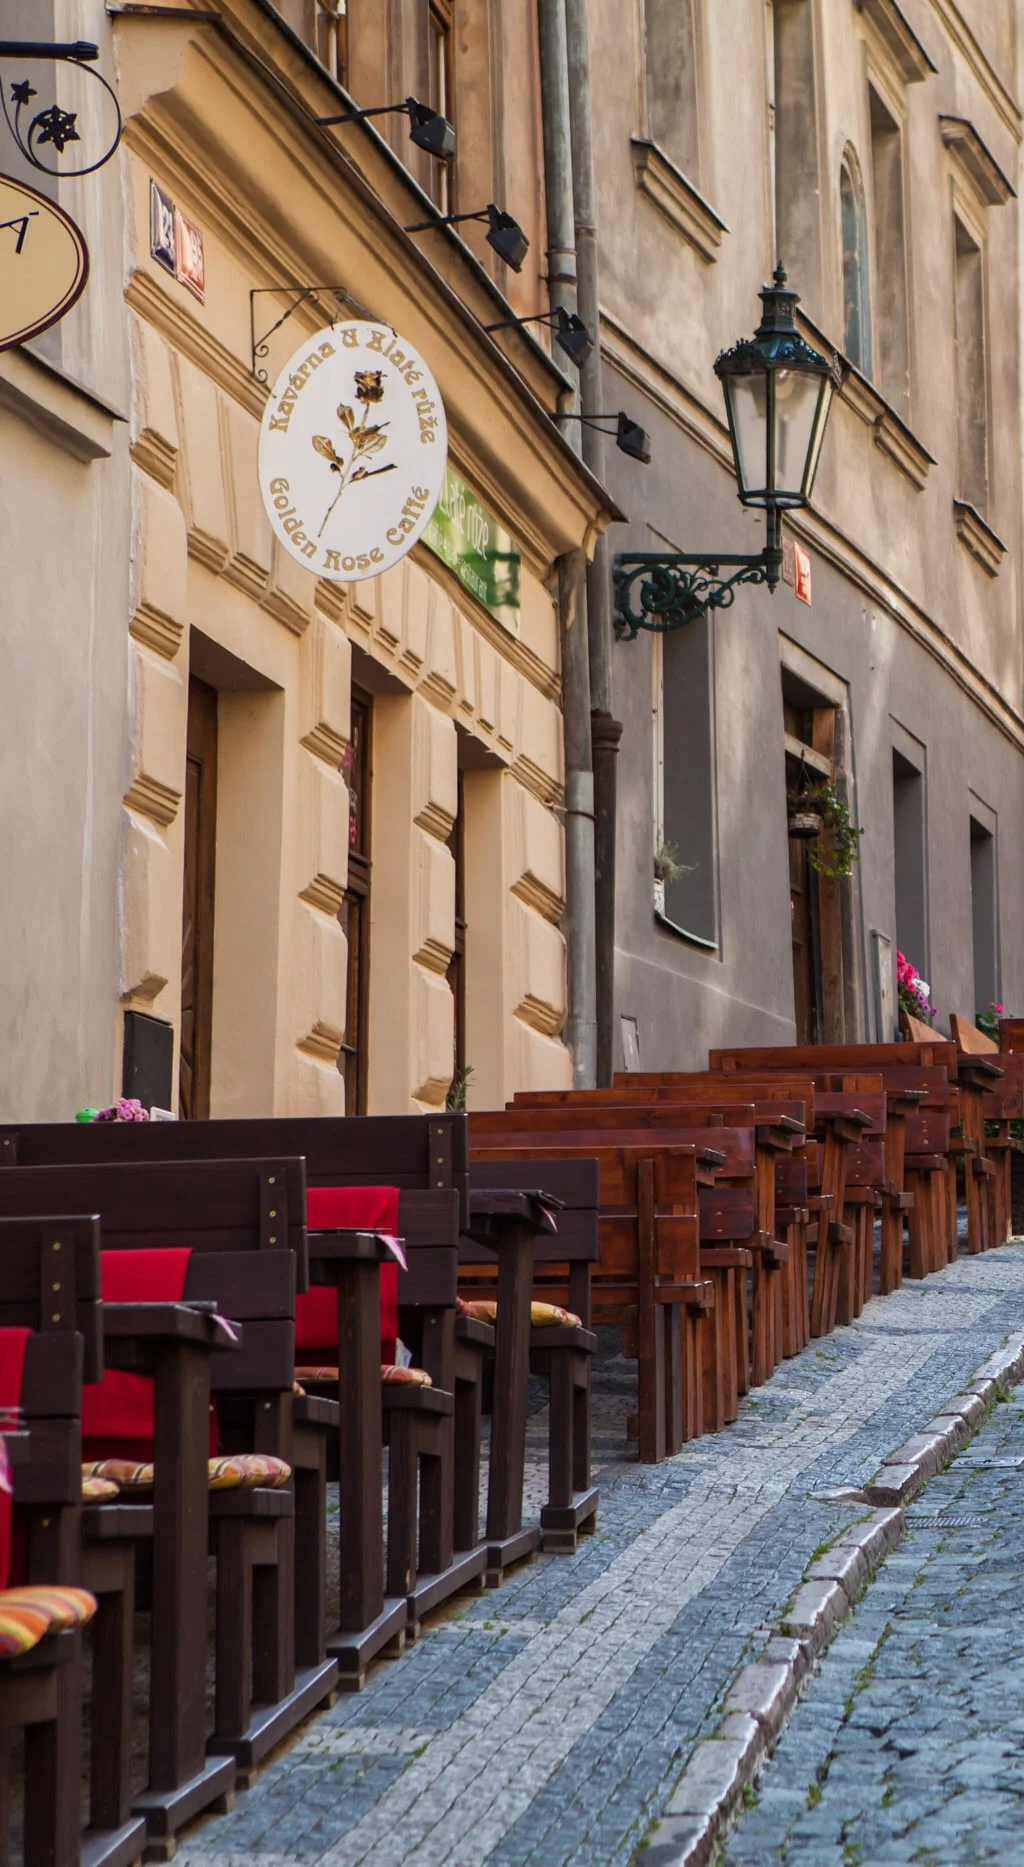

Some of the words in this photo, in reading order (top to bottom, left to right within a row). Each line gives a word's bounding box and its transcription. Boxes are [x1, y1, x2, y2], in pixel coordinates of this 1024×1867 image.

[269, 342, 336, 433] Kavárna
[365, 330, 425, 386] Zlaté
[411, 388, 439, 445] růže
[269, 477, 318, 559] Golden
[322, 546, 385, 572] Rose
[386, 485, 430, 546] Caffé
